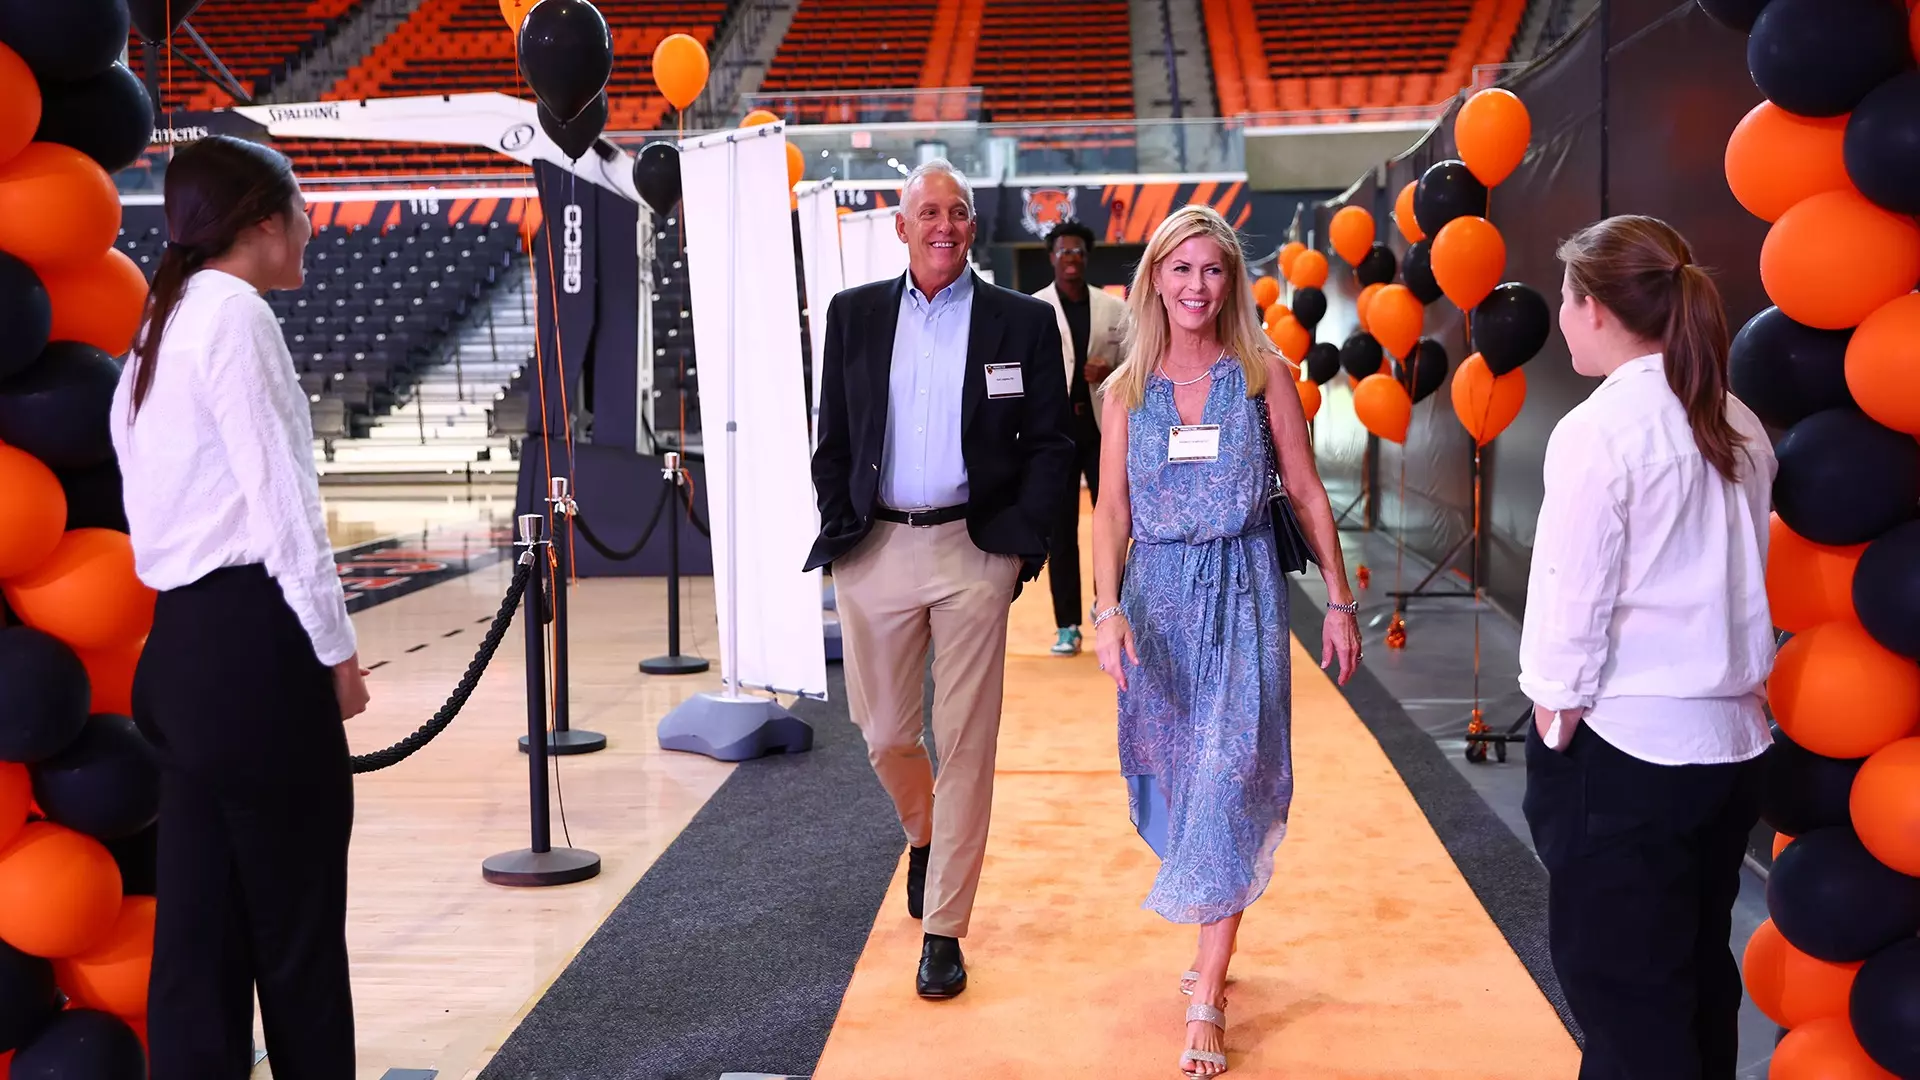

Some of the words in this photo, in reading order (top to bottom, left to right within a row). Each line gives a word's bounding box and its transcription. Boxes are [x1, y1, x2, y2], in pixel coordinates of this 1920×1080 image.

[268, 102, 340, 123] SPALDING
[150, 126, 209, 143] tments
[563, 204, 583, 294] GEICO
